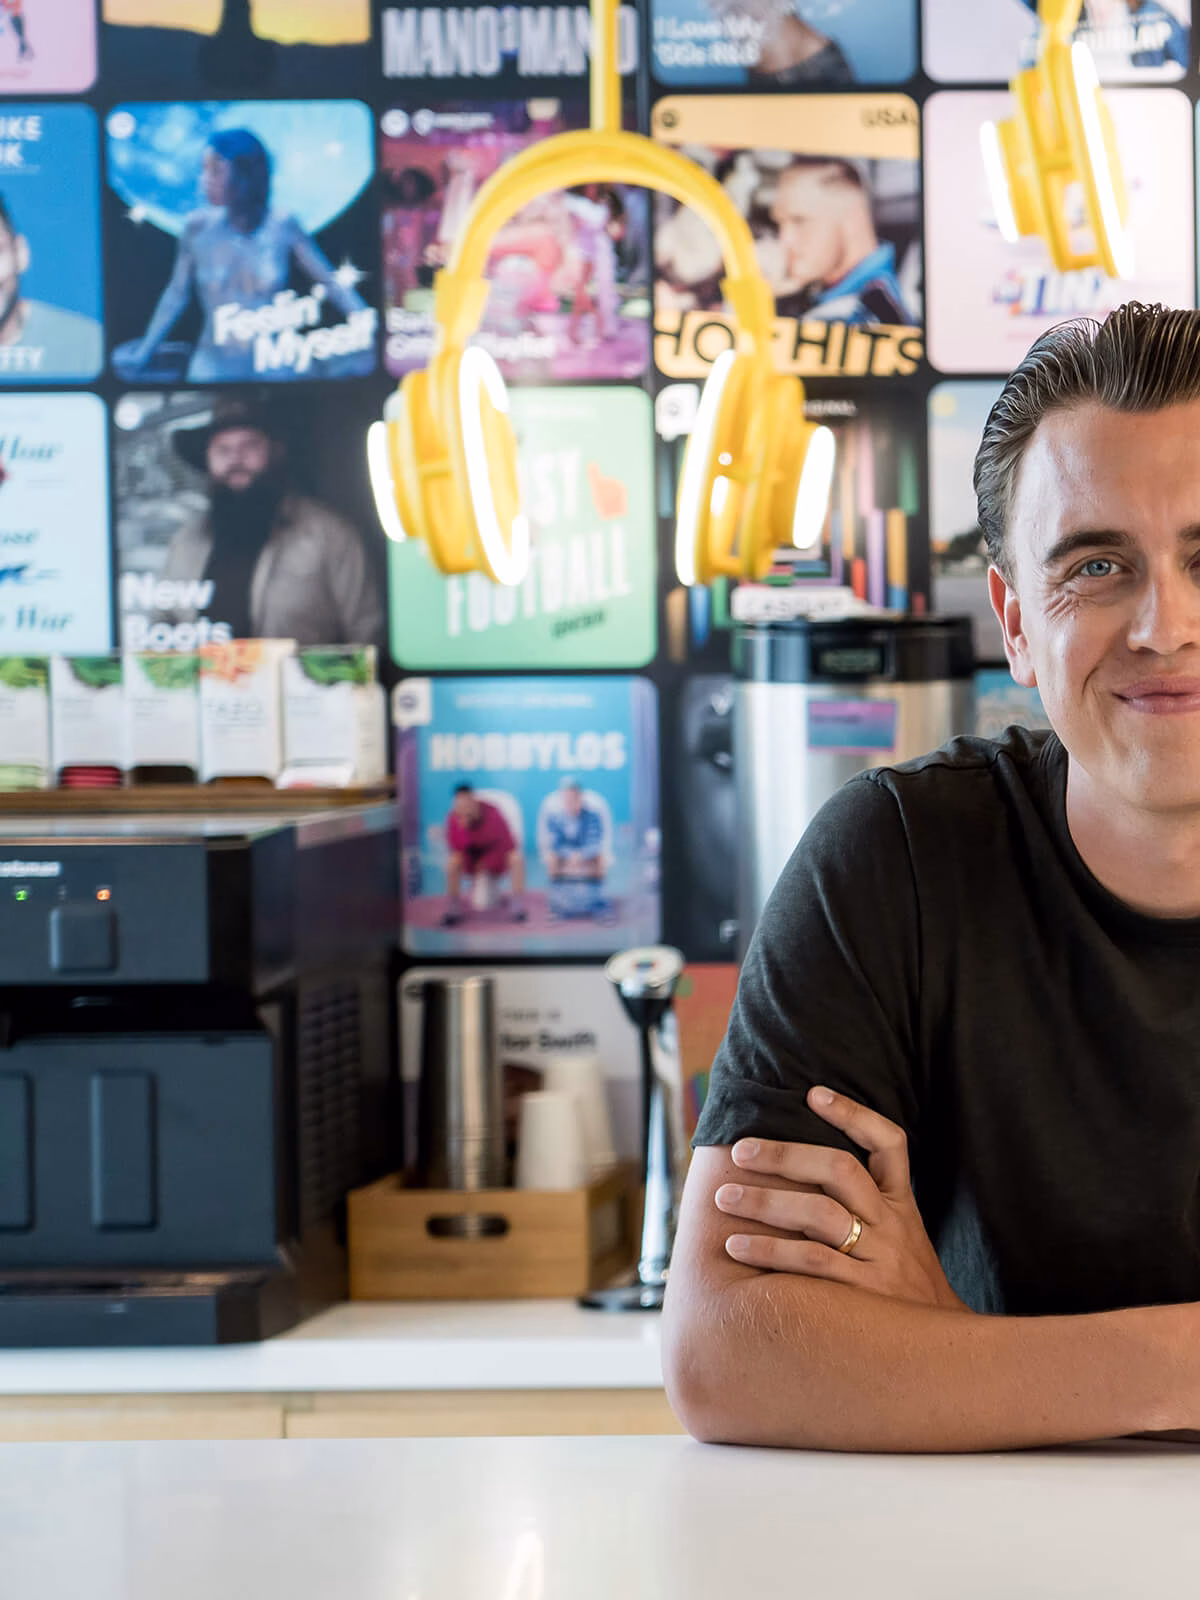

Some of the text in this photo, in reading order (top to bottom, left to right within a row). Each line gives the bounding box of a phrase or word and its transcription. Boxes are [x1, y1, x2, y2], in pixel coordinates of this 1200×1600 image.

[382, 8, 501, 78] MANO
[791, 317, 923, 373] HITS
[120, 571, 215, 610] New
[124, 612, 232, 652] Boots
[430, 730, 626, 770] HOBBYLOS
